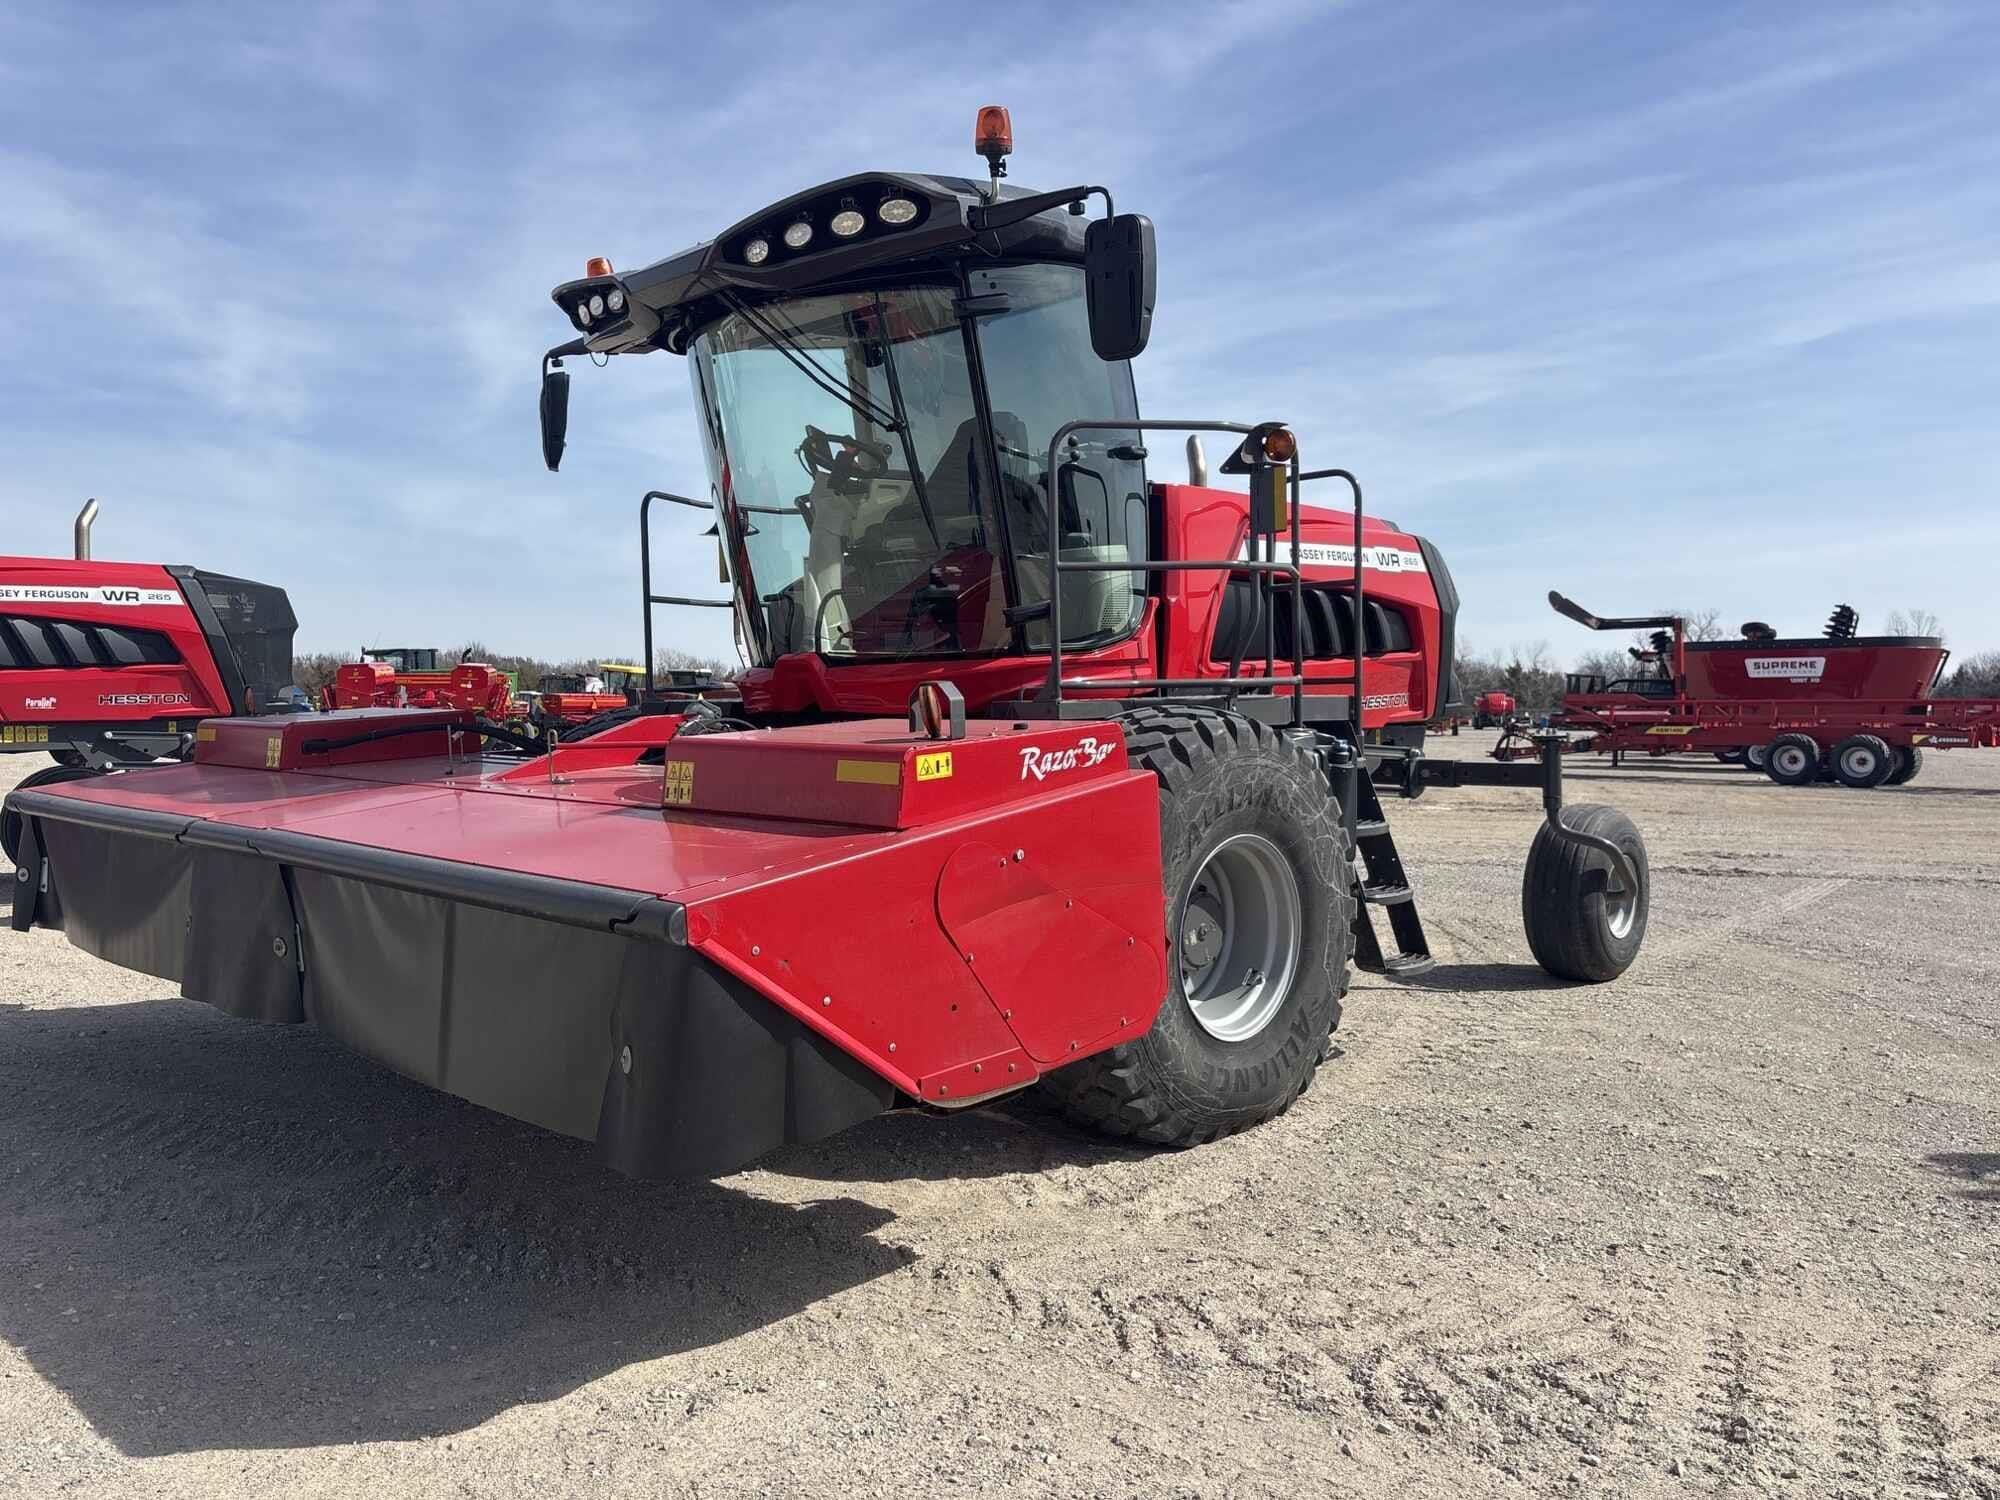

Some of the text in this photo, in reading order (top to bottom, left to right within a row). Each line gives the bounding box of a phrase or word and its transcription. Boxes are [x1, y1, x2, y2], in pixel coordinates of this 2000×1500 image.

[1376, 552, 1400, 567] WR
[25, 590, 89, 600] FERGUSON
[101, 590, 140, 602] WR
[1753, 661, 1817, 670] SUPREME
[98, 693, 191, 705] HESSTON
